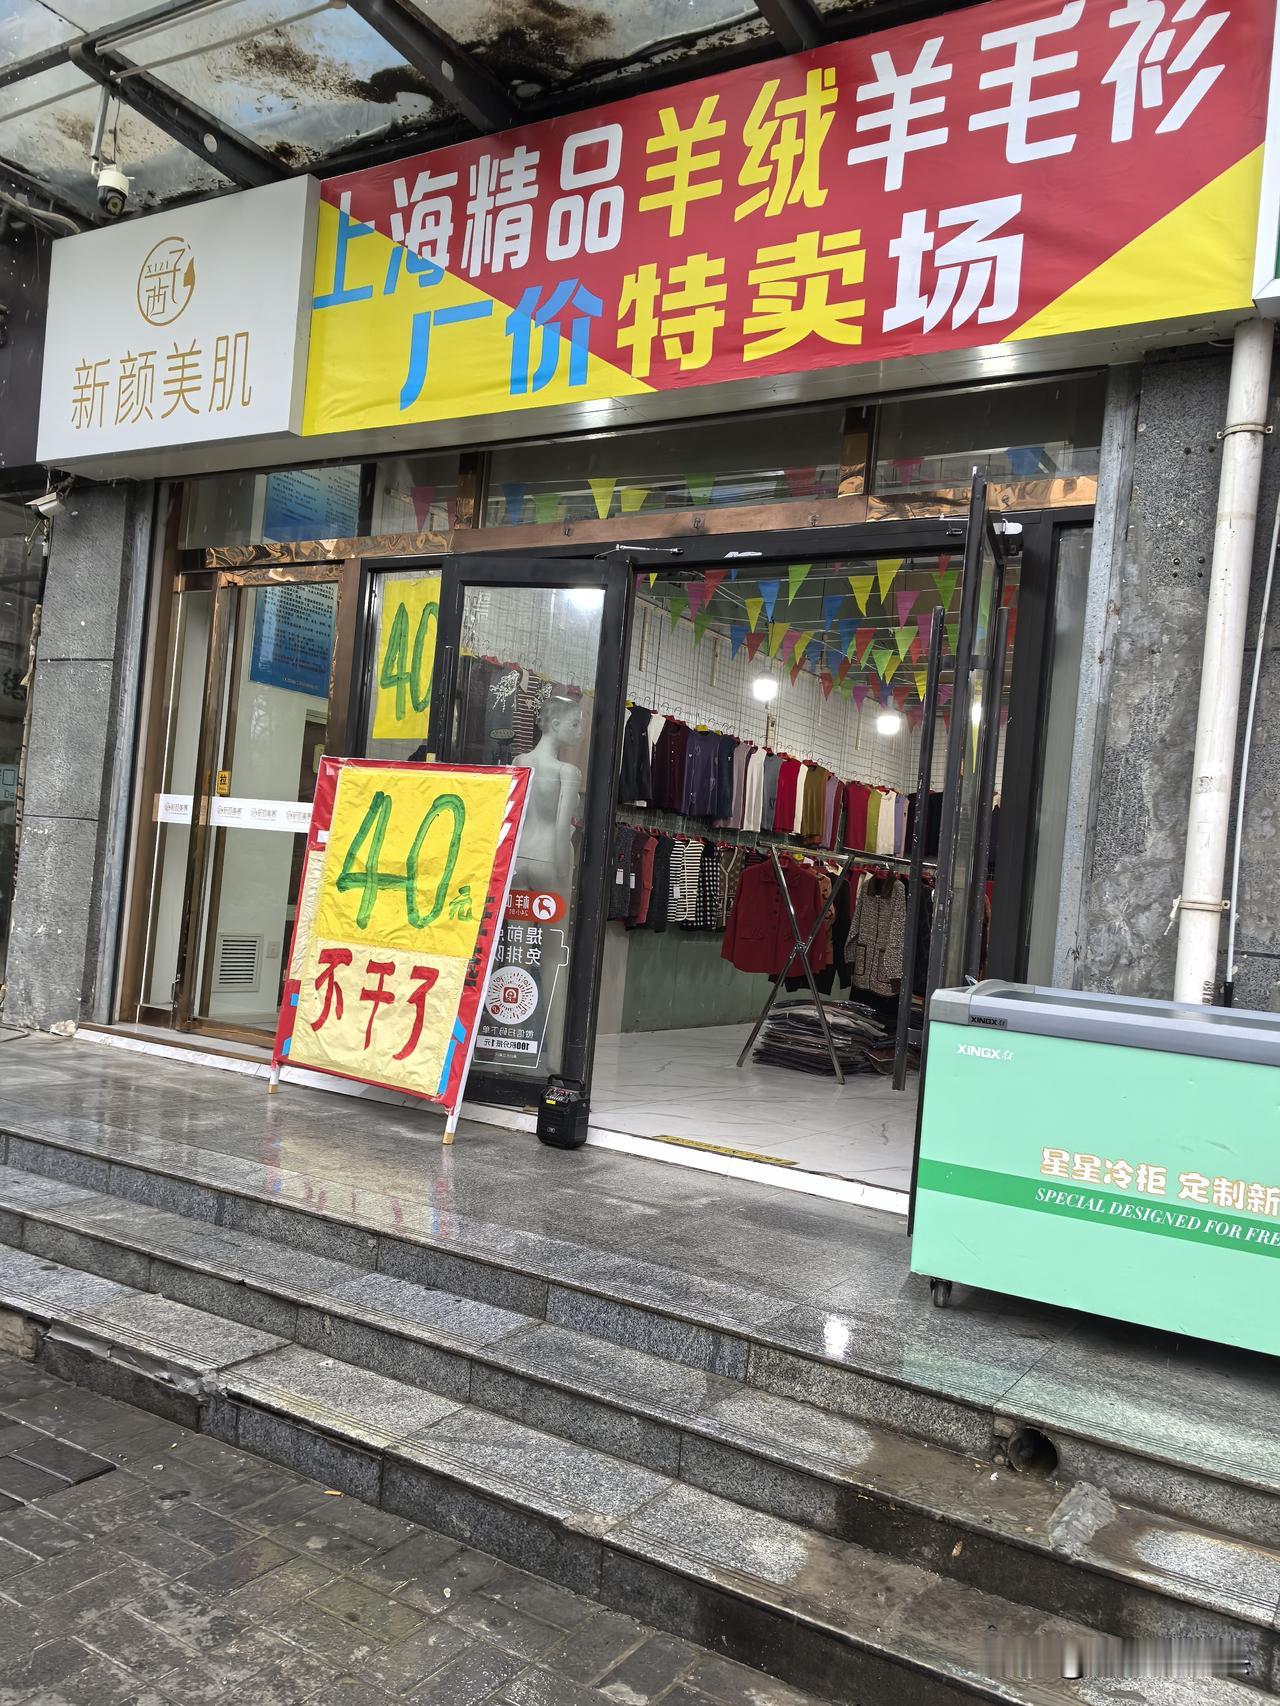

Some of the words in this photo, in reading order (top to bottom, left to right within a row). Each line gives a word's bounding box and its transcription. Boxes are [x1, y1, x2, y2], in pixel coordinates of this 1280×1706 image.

[314, 0, 1230, 310] 上海精品羊绒羊毛衫
[147, 260, 169, 274] XIZI
[400, 194, 1023, 409] 厂价特卖场
[72, 331, 252, 430] 新颜美肌
[381, 602, 438, 720] 40
[1035, 1188, 1106, 1213] SPECIAL
[1108, 1202, 1201, 1231] DESIGNED
[1204, 1219, 1242, 1240] FOR
[1040, 1148, 1168, 1196] 星星冷柜
[1178, 1173, 1280, 1217] 定制新
